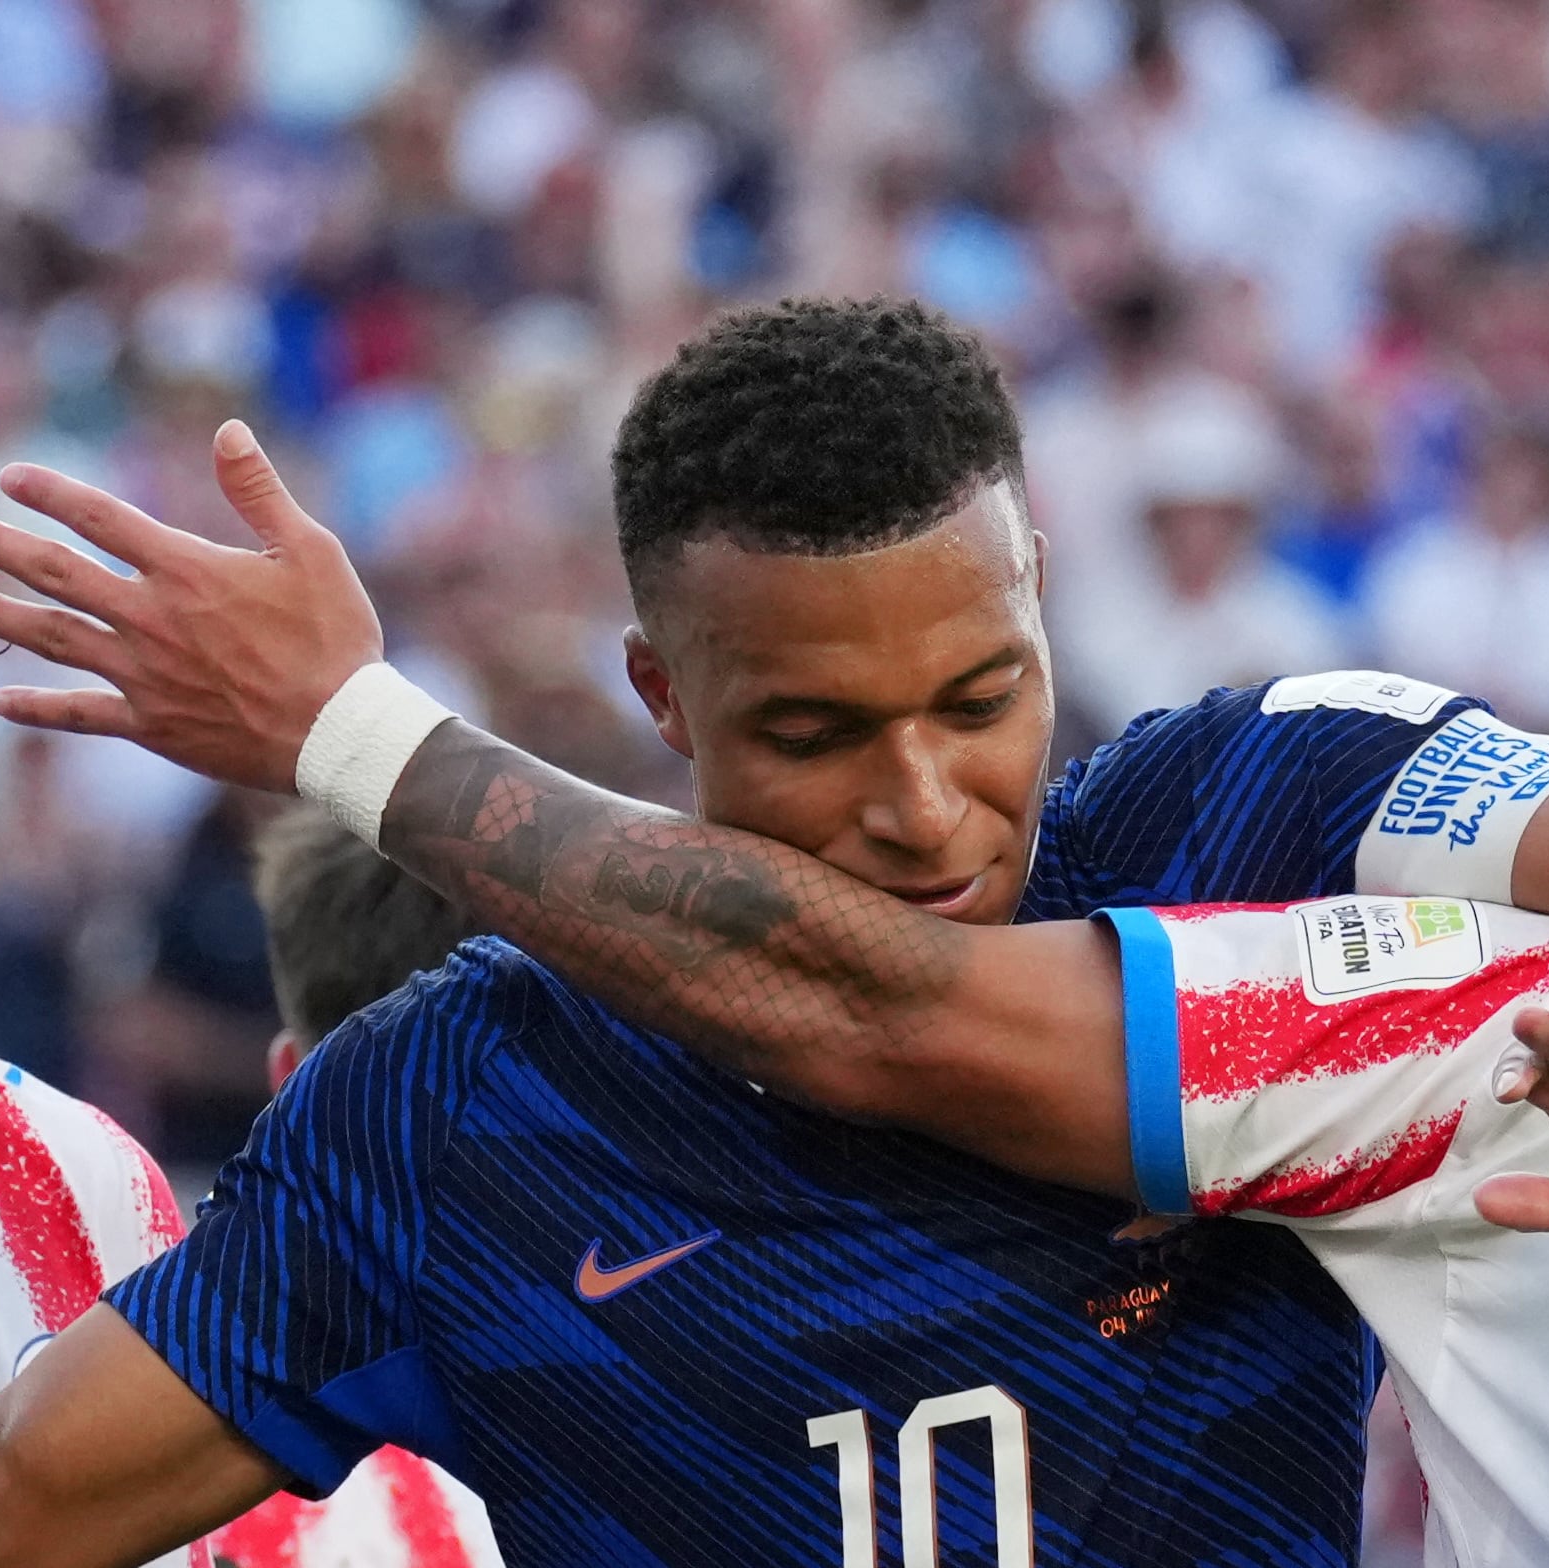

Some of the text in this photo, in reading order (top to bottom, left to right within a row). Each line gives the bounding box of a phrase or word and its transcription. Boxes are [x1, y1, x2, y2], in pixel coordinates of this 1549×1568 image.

[1379, 718, 1489, 835] FOOTBALL
[1406, 732, 1532, 835] UNITES
[1448, 794, 1497, 852] the
[1373, 927, 1405, 957] For
[1086, 1279, 1171, 1317] PARAGUAY
